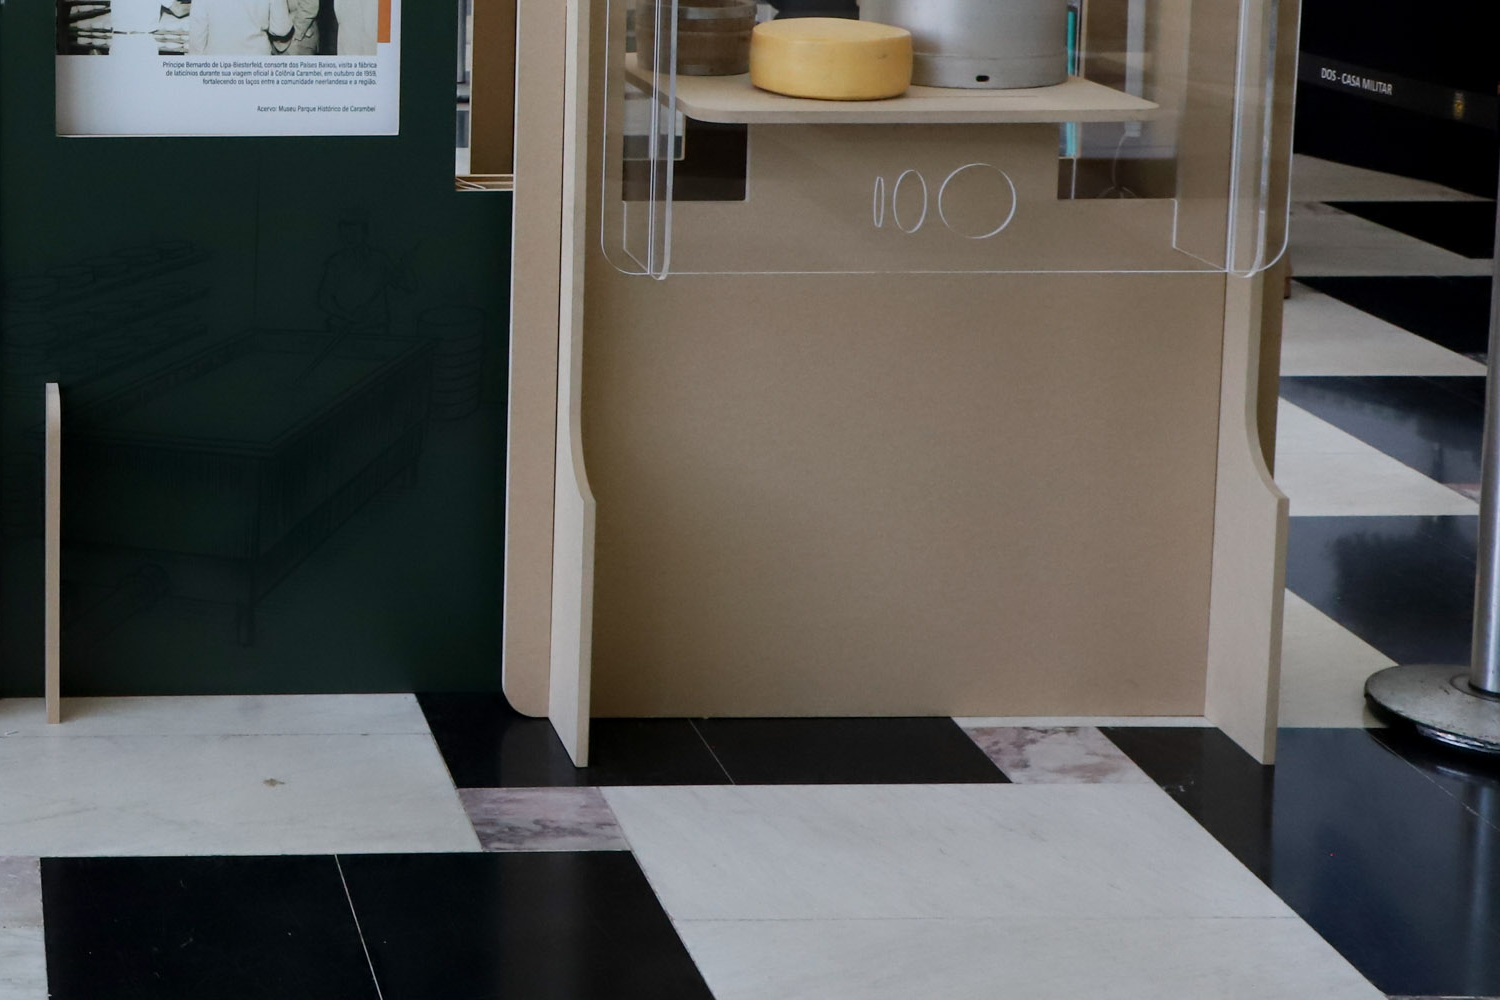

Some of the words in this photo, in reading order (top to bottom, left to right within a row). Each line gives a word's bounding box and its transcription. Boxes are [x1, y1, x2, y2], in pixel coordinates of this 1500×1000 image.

[1321, 67, 1336, 81] DOS
[1342, 73, 1361, 87] CASA
[1362, 79, 1392, 95] MILITAR
